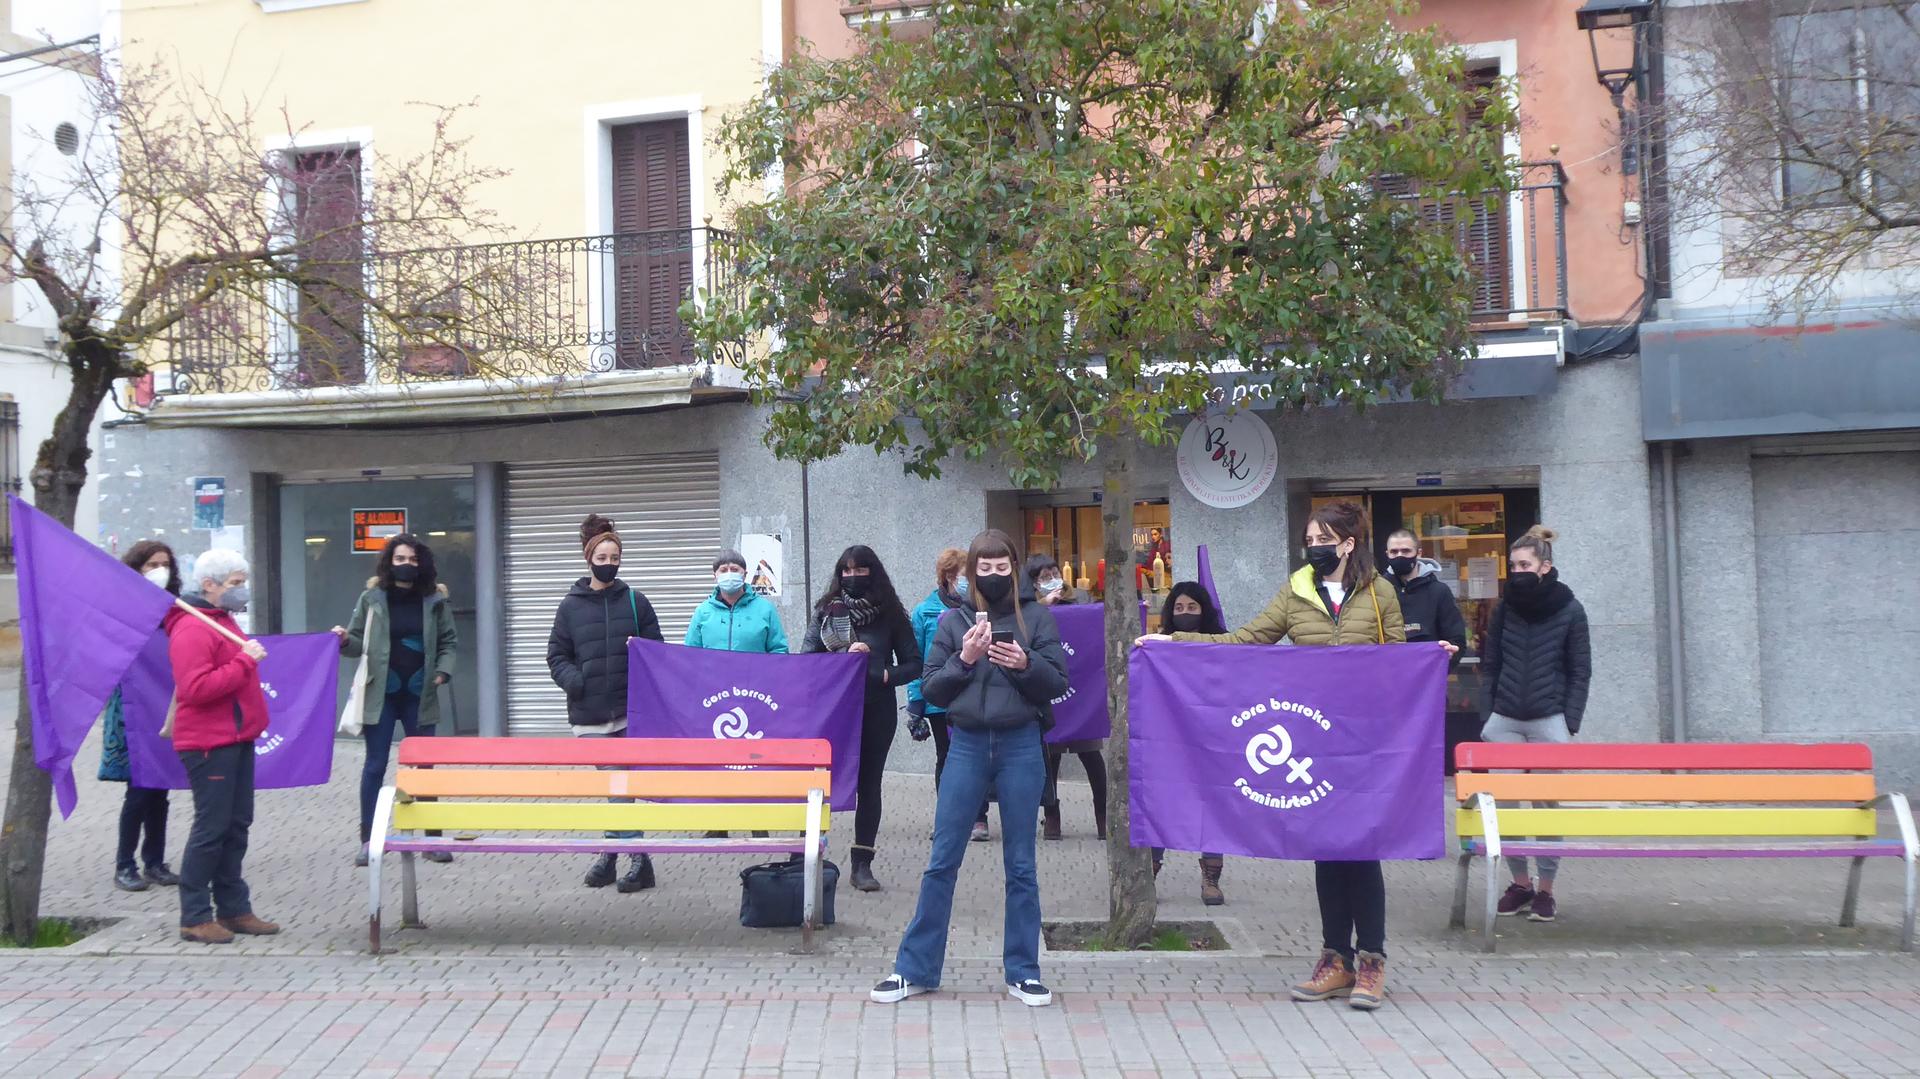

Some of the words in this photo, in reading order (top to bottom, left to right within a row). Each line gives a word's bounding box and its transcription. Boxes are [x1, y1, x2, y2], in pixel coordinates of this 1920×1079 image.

[354, 512, 367, 525] SE
[367, 512, 404, 525] ALQUILA
[702, 690, 730, 708] Gora
[733, 686, 778, 711] borroka
[1231, 703, 1267, 728] Gora
[1269, 697, 1331, 731] borroka
[1233, 777, 1334, 809] Feminista!!!
